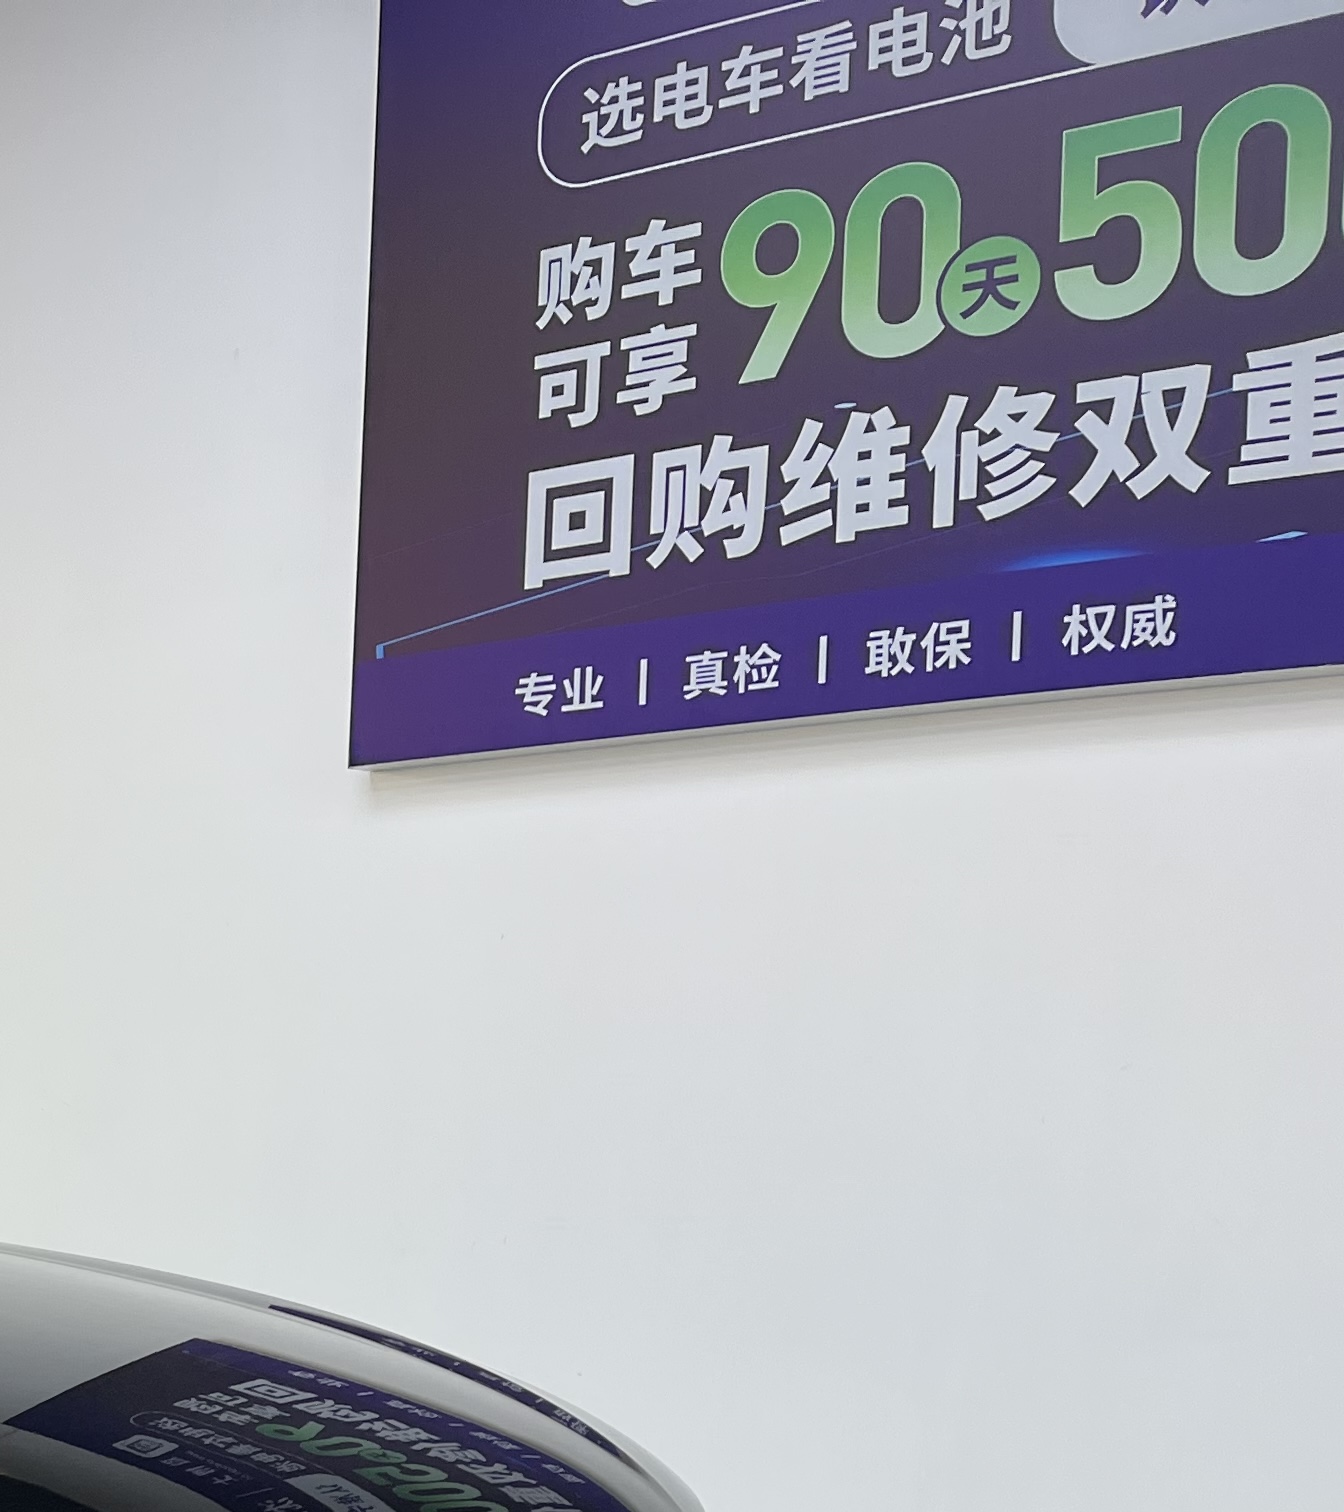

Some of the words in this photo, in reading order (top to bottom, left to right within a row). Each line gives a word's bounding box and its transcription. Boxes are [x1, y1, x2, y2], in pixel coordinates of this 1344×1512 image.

[580, 0, 1012, 154] 选电车看电池
[536, 218, 704, 331] 购车
[534, 322, 699, 429] 可享
[514, 665, 605, 719] 专业
[682, 643, 783, 701] 真检
[864, 616, 974, 679] 敢保
[1062, 594, 1179, 655] 权威
